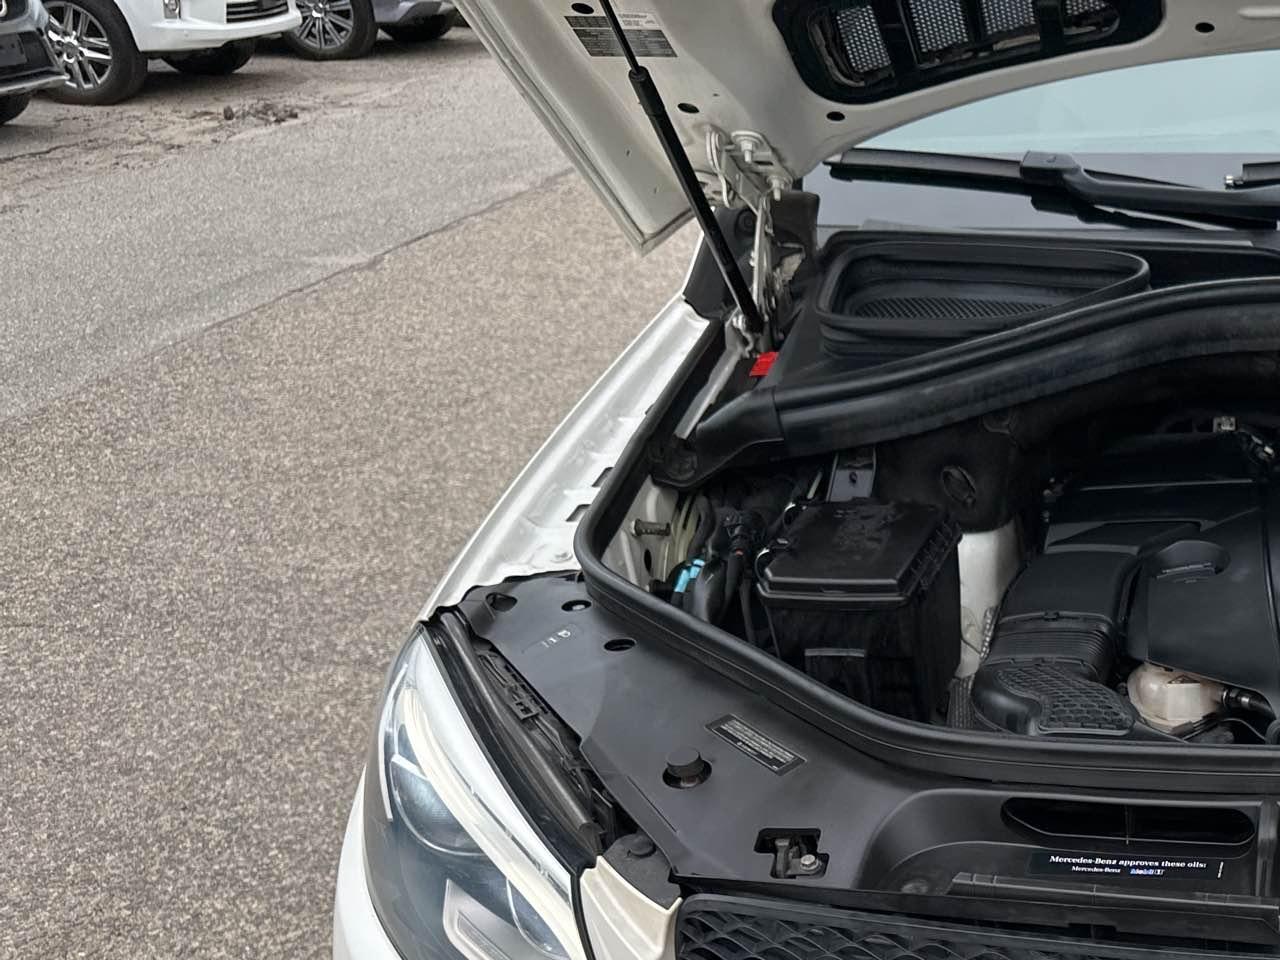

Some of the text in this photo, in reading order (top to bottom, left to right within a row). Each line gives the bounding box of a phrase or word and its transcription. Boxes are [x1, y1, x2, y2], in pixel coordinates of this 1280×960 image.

[1049, 855, 1117, 865] Mercedes-Benz
[1118, 859, 1159, 867] approves
[1161, 860, 1186, 868] these
[1071, 865, 1121, 873] Mercedes-Benz
